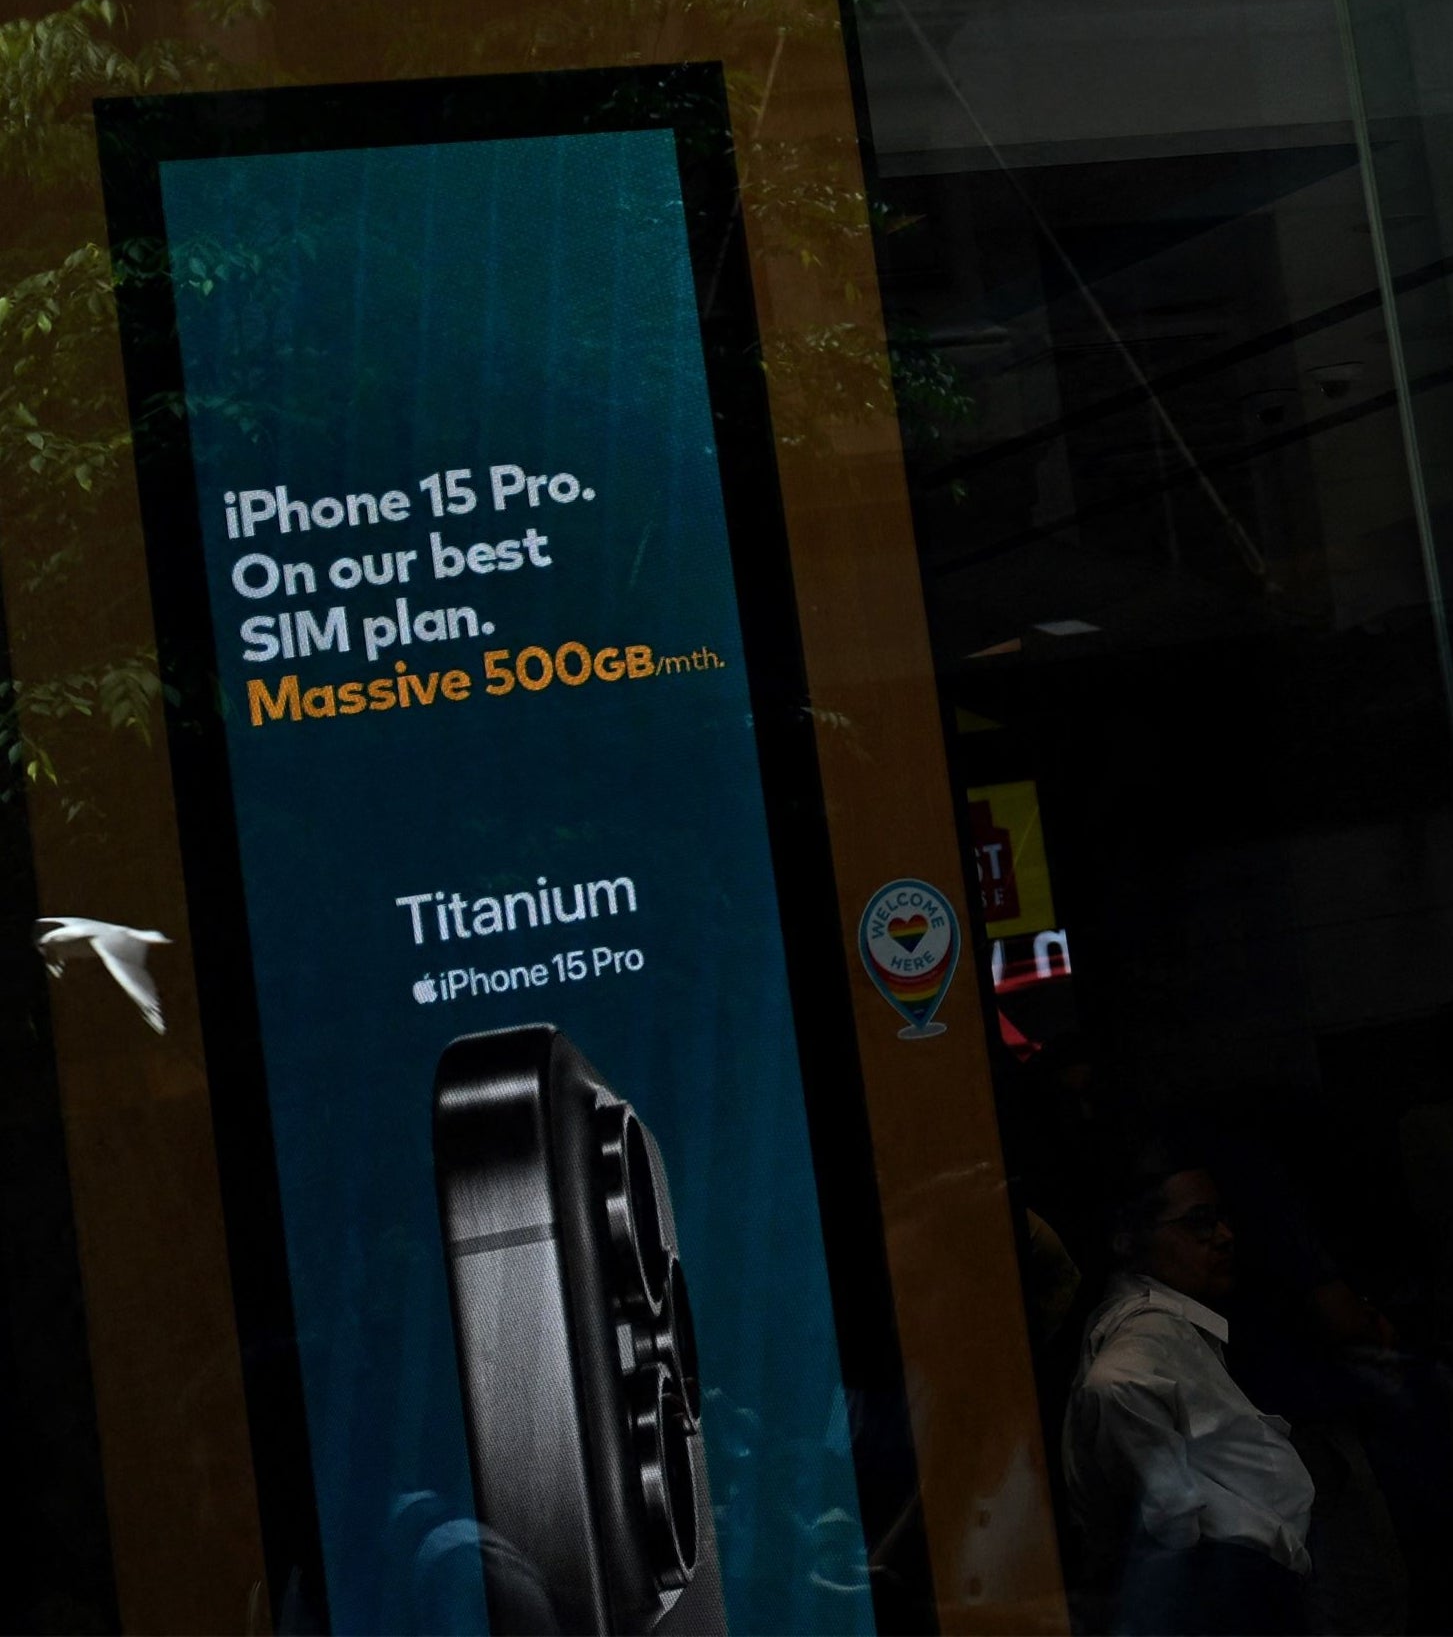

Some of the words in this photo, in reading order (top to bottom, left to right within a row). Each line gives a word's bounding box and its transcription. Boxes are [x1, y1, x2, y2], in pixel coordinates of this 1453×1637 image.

[223, 486, 411, 540] iPhone
[420, 469, 477, 517] 15
[489, 464, 597, 511] Pro.
[231, 553, 316, 599] On
[328, 547, 418, 589] our
[429, 528, 552, 579] best
[239, 605, 350, 662] SIM
[362, 598, 496, 661] plan.
[246, 660, 473, 727] Massive
[396, 875, 638, 945] Titanium
[872, 892, 945, 940] WELCOME
[439, 959, 549, 1001] iPhone
[551, 948, 588, 982] 15
[592, 944, 645, 978] Pro
[891, 950, 936, 972] HERE
